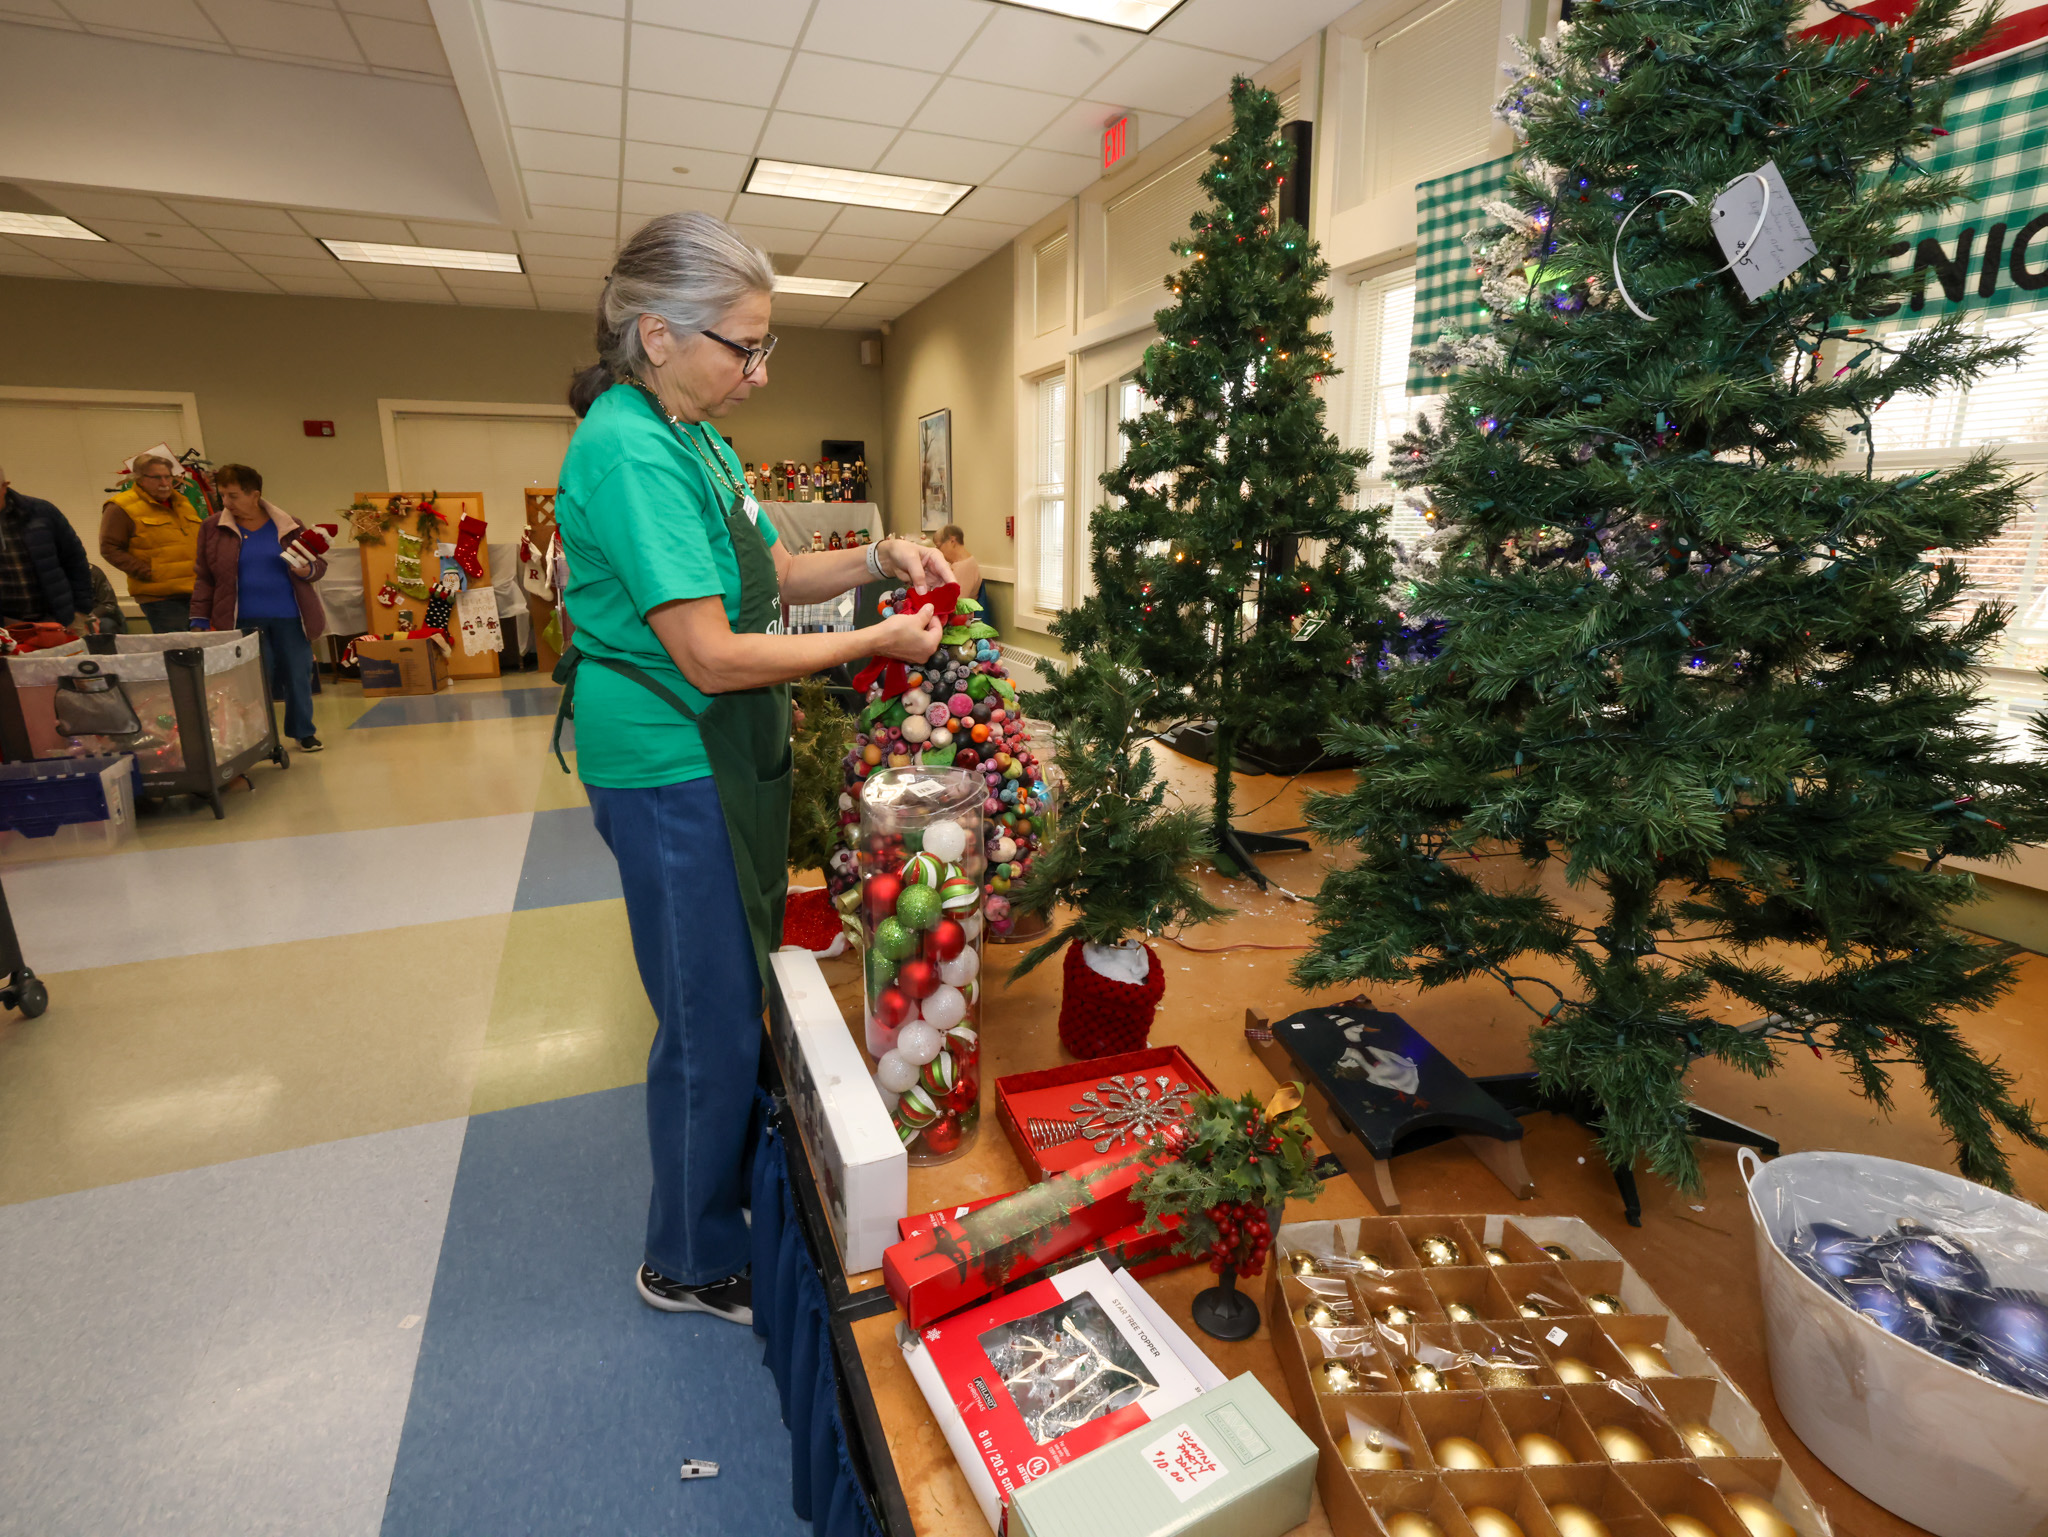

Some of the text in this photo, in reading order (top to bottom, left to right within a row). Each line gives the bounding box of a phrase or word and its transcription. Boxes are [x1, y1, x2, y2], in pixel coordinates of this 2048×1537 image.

[1104, 117, 1127, 168] EXIT
[529, 569, 539, 580] R
[1112, 1298, 1161, 1358] STAR TREE TOPPER
[967, 1382, 986, 1412] CHRISTMAS
[978, 1429, 989, 1439] 8
[982, 1437, 993, 1451] in
[1176, 1443, 1209, 1474] PARTY
[1177, 1430, 1217, 1472] SKATING
[990, 1453, 1009, 1477] 20.3
[1016, 1463, 1032, 1484] LISTED
[1175, 1454, 1198, 1482] DOLL
[1001, 1478, 1015, 1494] cm
